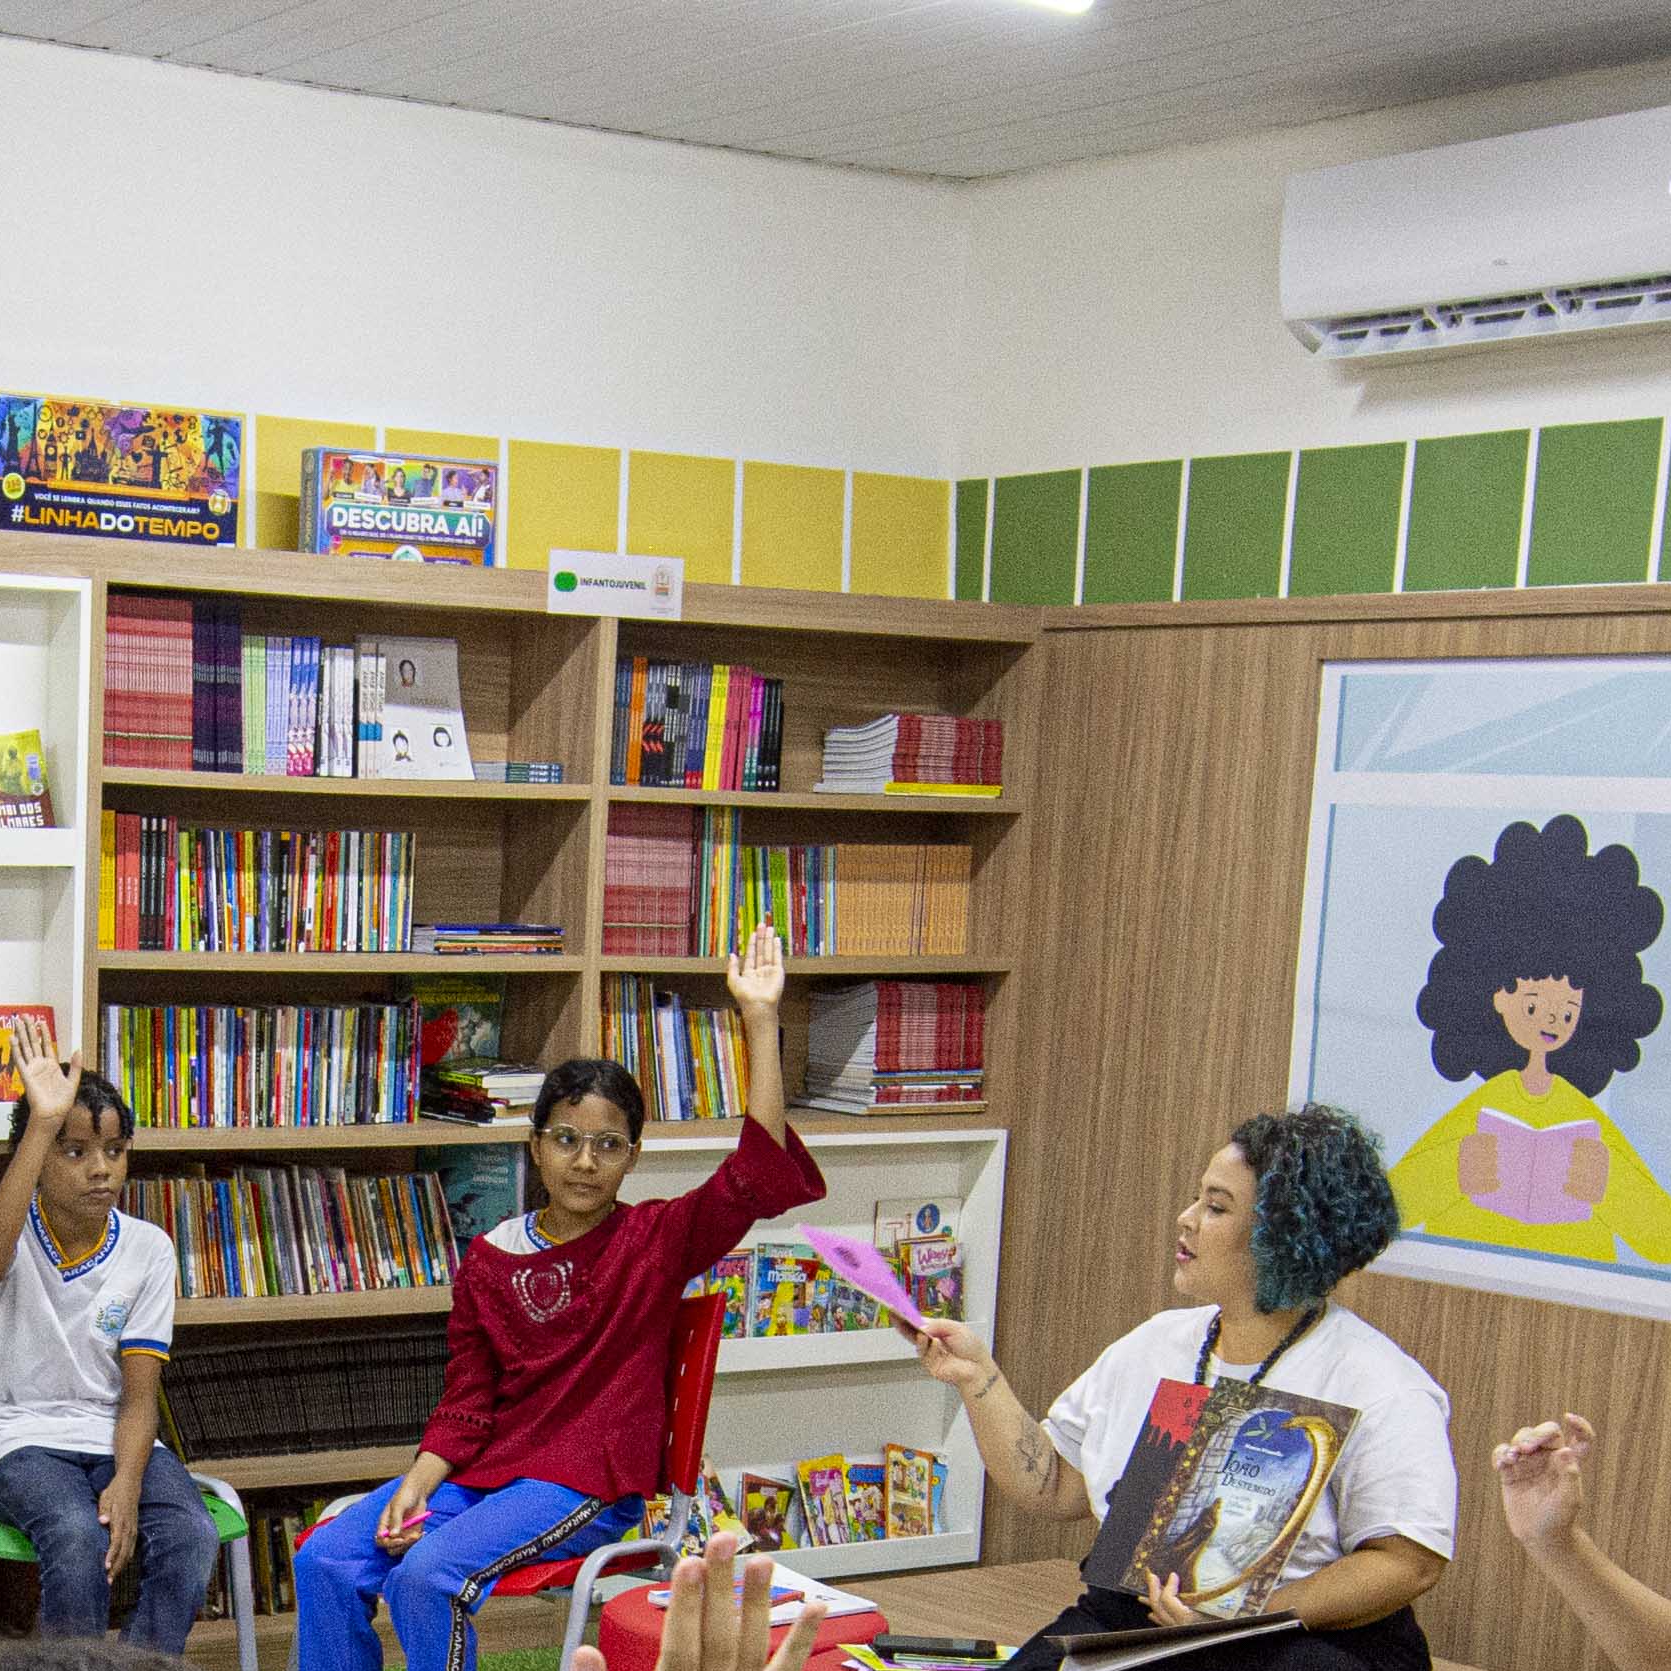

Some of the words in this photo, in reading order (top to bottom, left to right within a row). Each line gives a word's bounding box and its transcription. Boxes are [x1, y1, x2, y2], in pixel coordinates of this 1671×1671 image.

[10, 504, 221, 541] #LINHADOTEMPO
[331, 505, 449, 537] DESCUBRA
[455, 511, 484, 539] AÍ!
[579, 577, 647, 592] INFANTOJUVENIL
[19, 801, 42, 816] DOS
